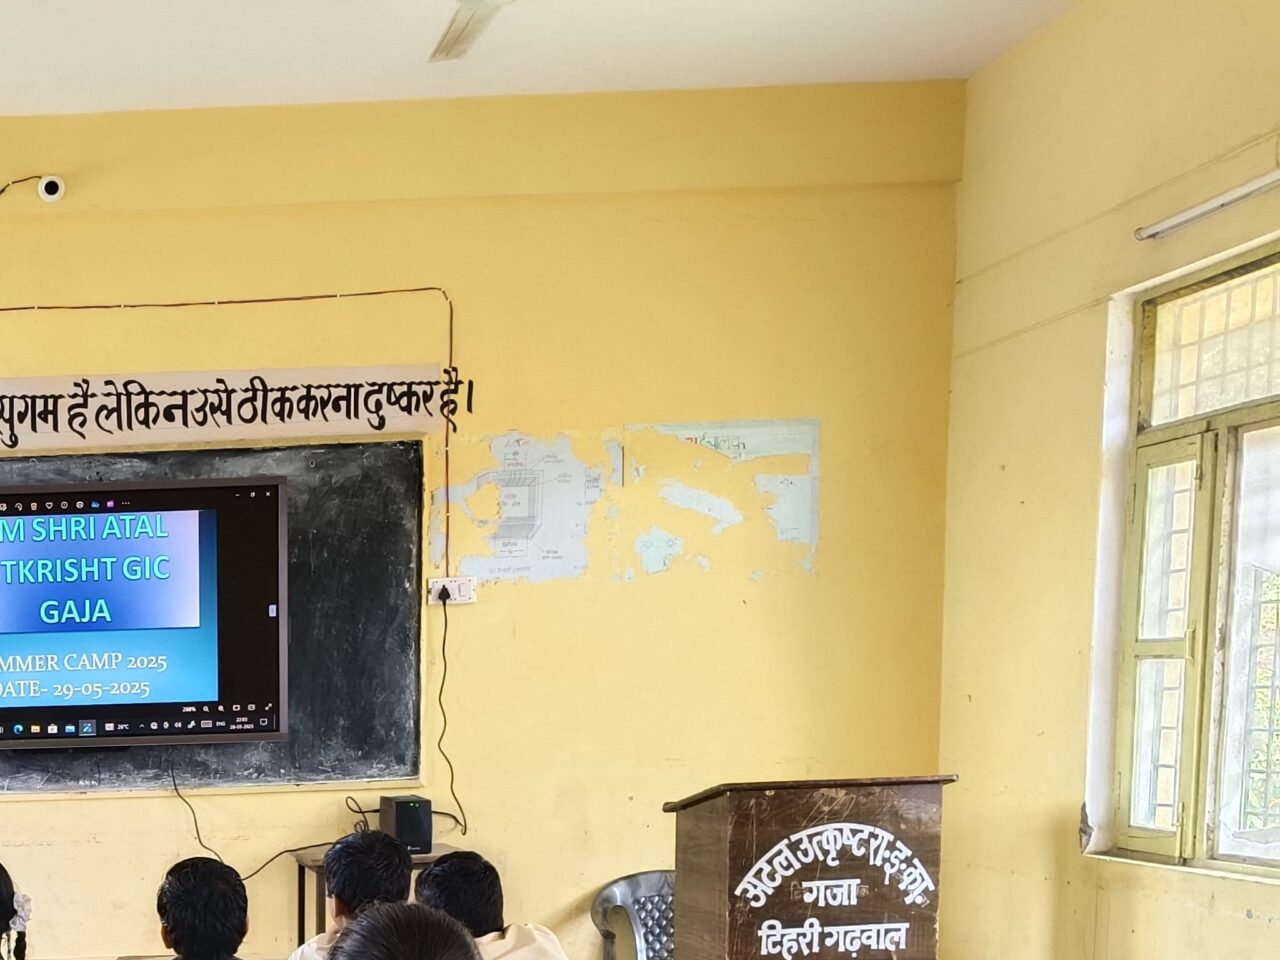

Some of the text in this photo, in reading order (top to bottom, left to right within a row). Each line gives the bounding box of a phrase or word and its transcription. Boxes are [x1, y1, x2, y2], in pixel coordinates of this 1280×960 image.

[65, 379, 99, 439] है
[96, 379, 196, 432] लेकिन
[31, 515, 97, 542] SHRI
[100, 512, 169, 540] ATAL
[121, 554, 171, 581] GIC
[39, 599, 112, 625] GAJA
[63, 652, 123, 671] CAMP
[127, 653, 168, 670] 2025
[53, 680, 150, 699] 29-05-2025
[734, 839, 801, 908] अटल
[790, 822, 871, 867] उत्कृष्ट
[802, 878, 861, 907] गजा
[824, 921, 910, 958] गढ़वाल
